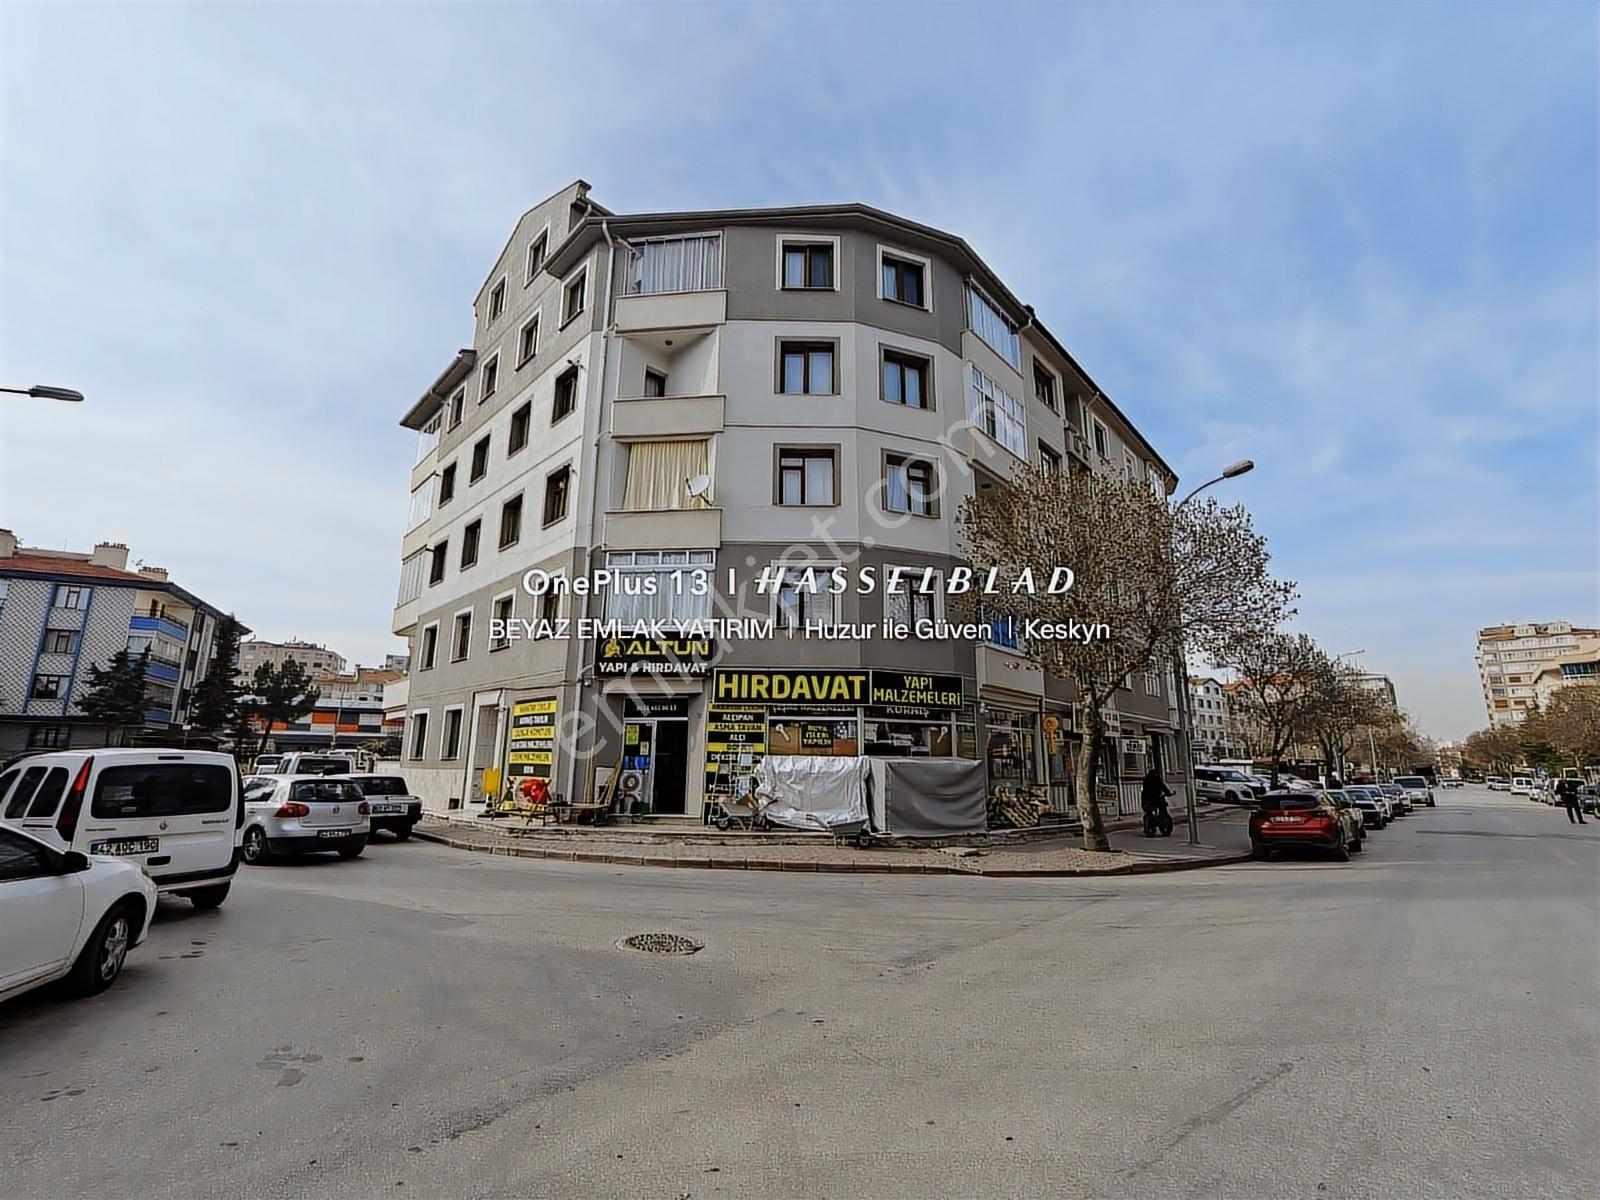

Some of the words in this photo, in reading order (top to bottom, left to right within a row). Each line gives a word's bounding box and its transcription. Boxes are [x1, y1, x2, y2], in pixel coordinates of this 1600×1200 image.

[626, 640, 709, 656] ALTUN
[599, 662, 627, 673] YAPI
[642, 661, 708, 673] HIRDAVAT
[718, 674, 866, 699] HIRDAVAT
[903, 675, 933, 690] YAPI
[873, 688, 961, 707] MALZEMELERİ
